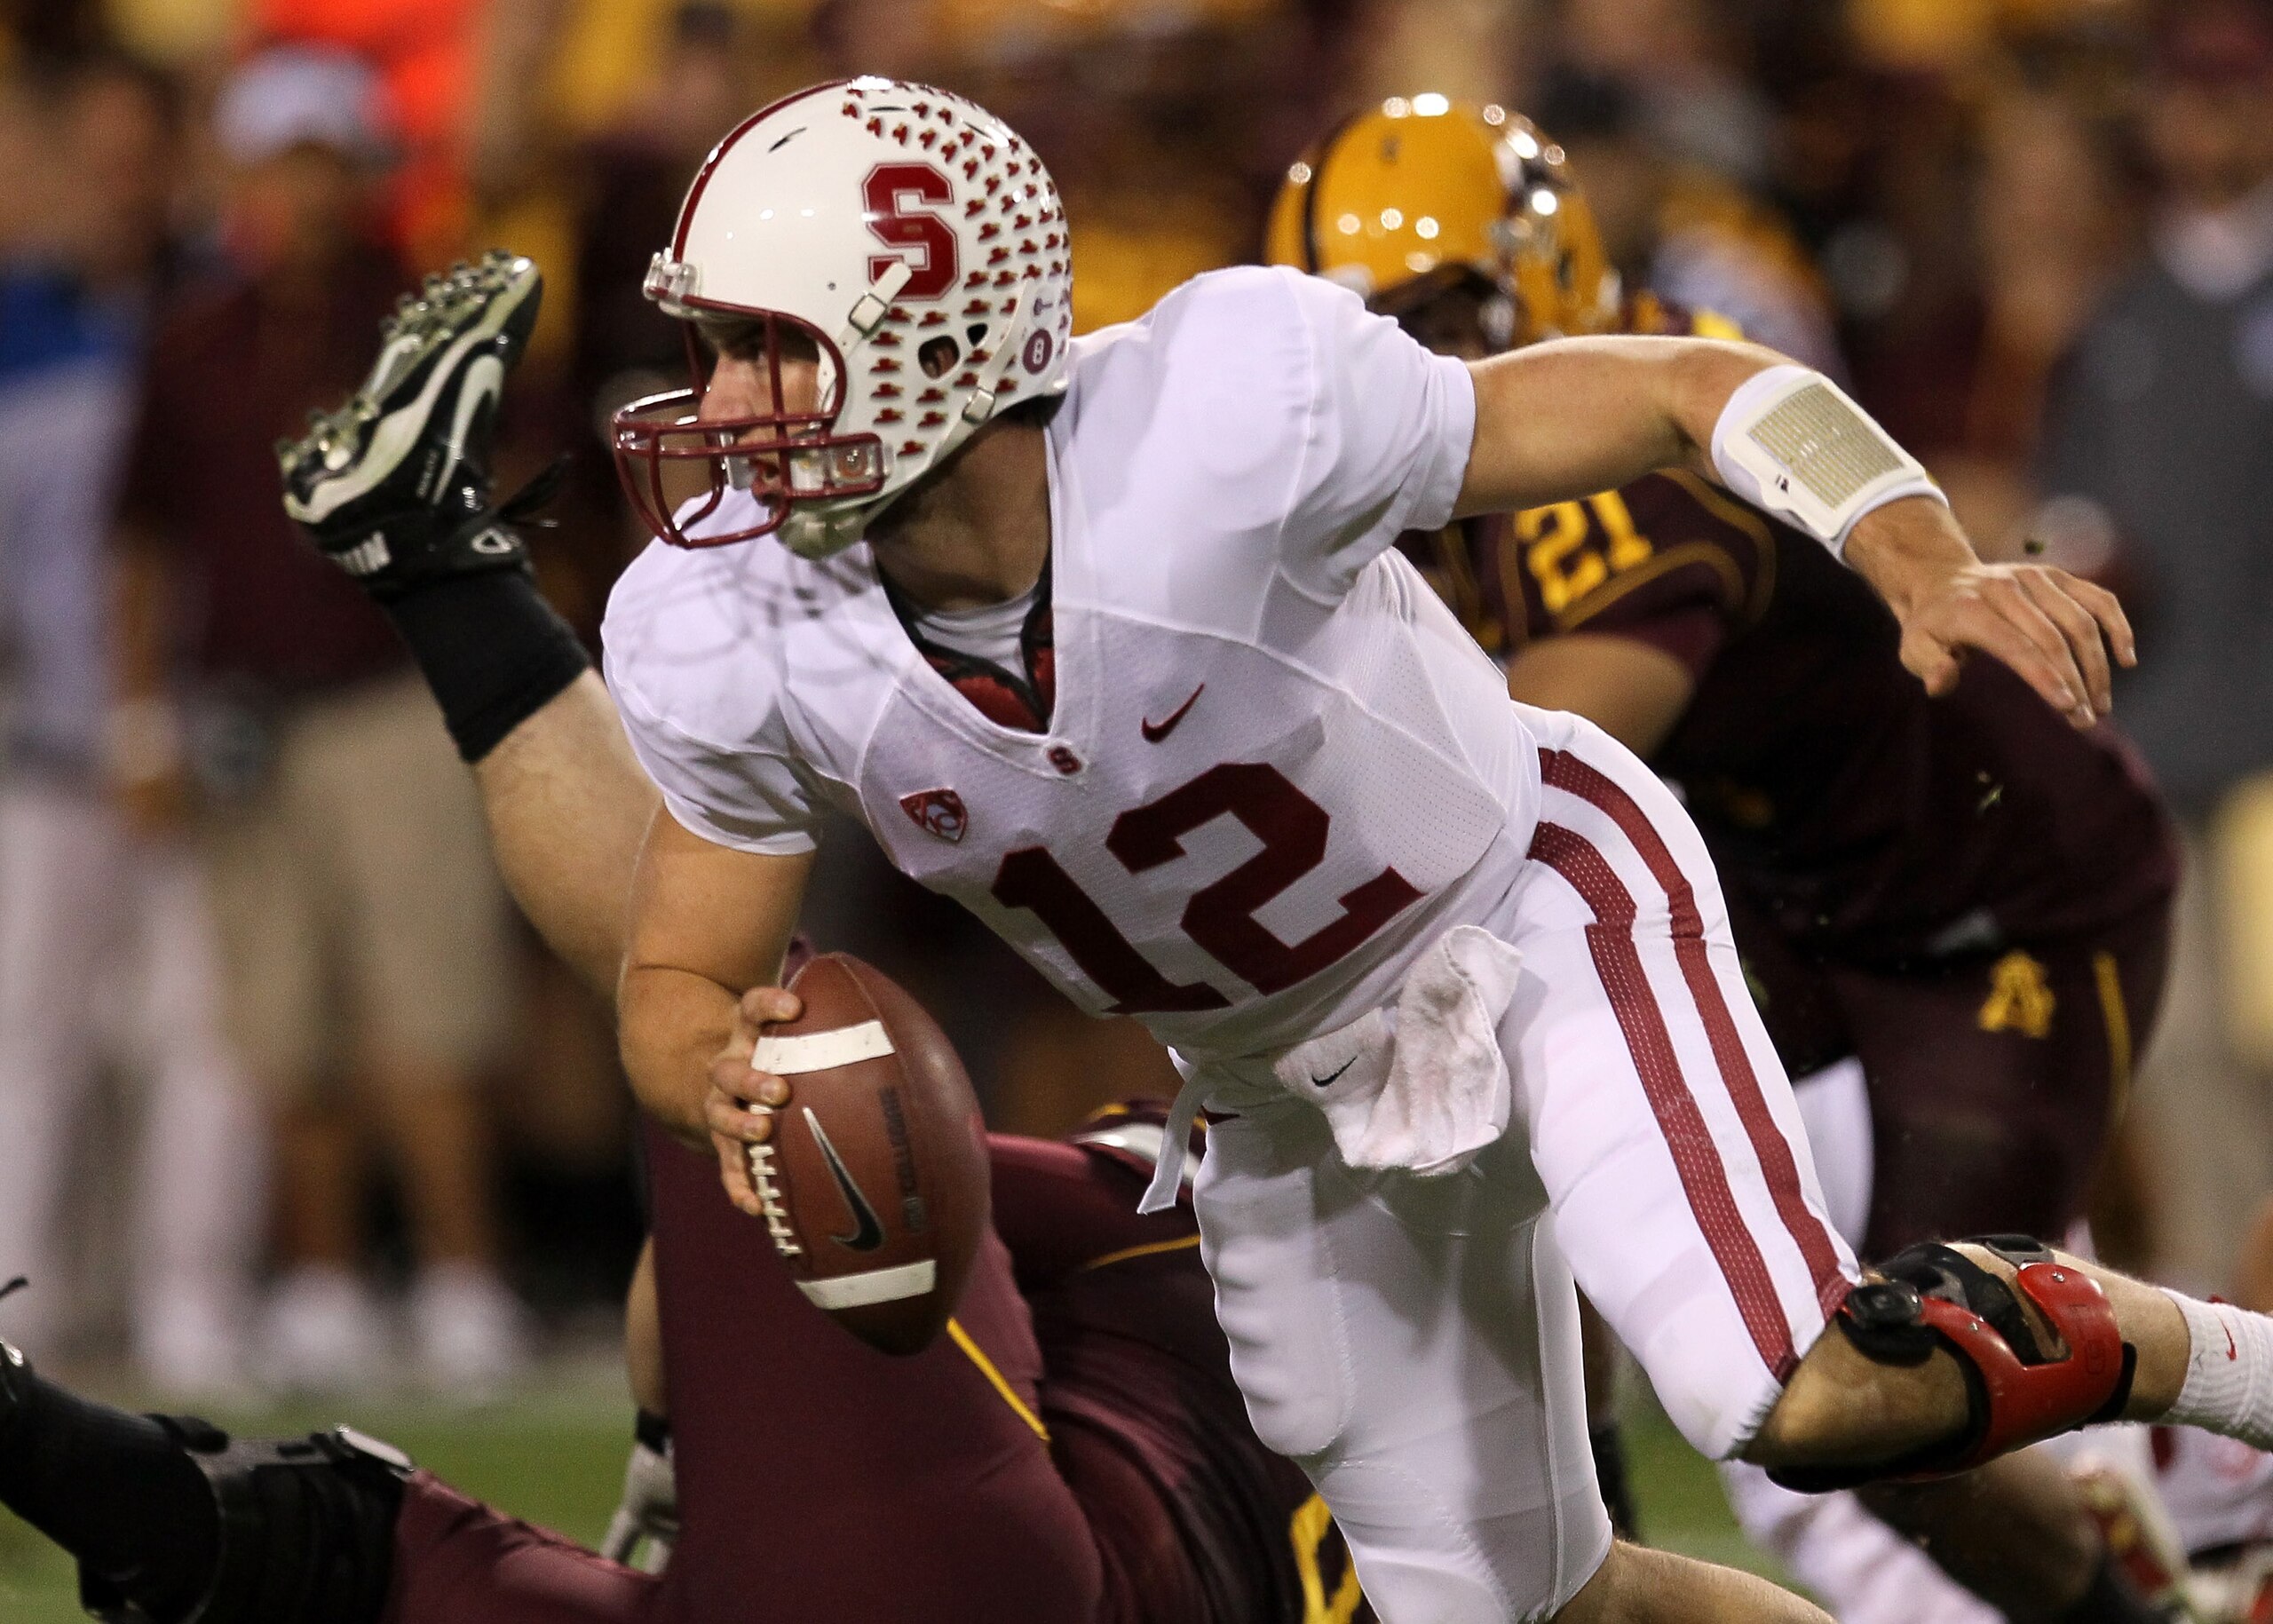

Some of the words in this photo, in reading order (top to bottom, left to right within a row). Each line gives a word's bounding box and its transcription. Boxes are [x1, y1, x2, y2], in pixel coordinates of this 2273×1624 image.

[862, 162, 960, 302] S
[1514, 490, 1652, 610] 21
[991, 763, 1428, 1015] 12
